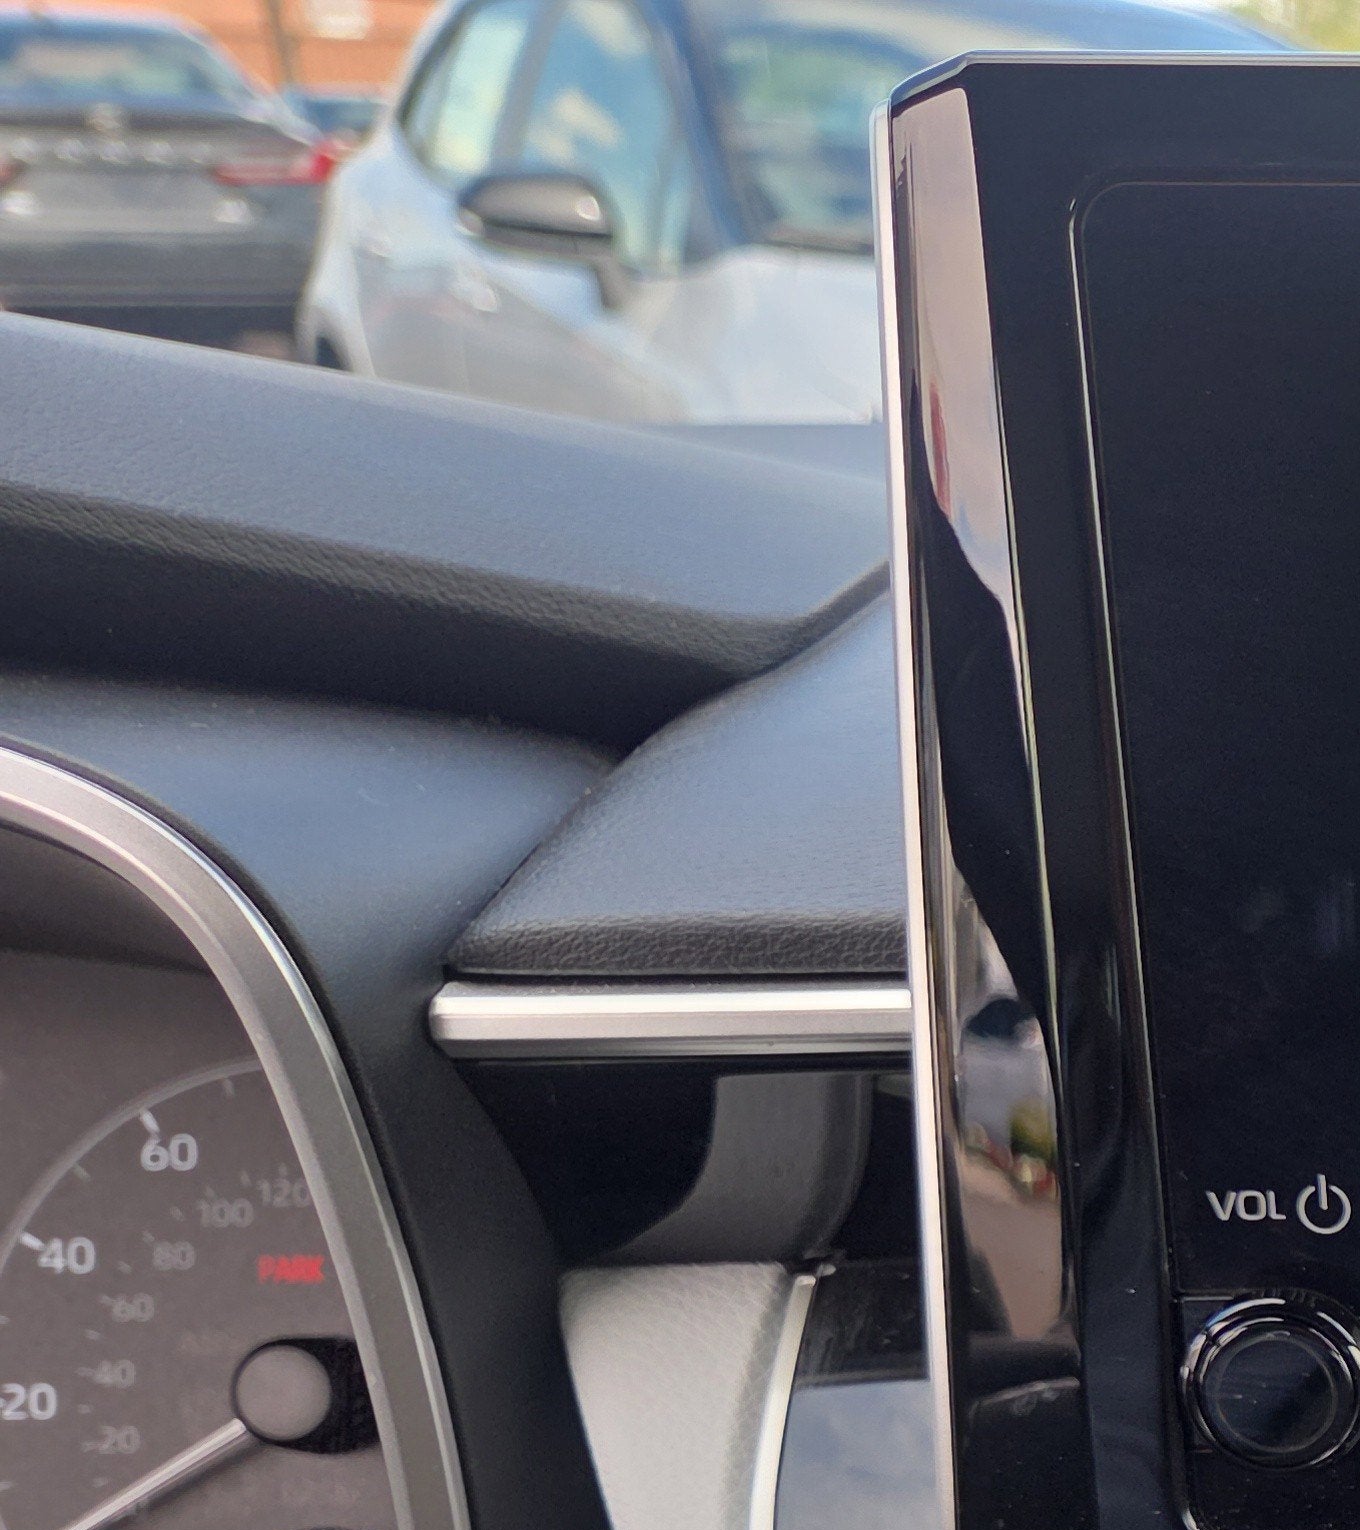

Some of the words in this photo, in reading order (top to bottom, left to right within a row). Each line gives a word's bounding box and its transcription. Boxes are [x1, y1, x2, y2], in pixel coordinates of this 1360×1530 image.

[139, 1133, 198, 1172] 60
[1205, 1189, 1287, 1221] VOL
[38, 1236, 96, 1275] 40
[256, 1254, 325, 1285] PARK
[0, 1382, 58, 1421] 20
